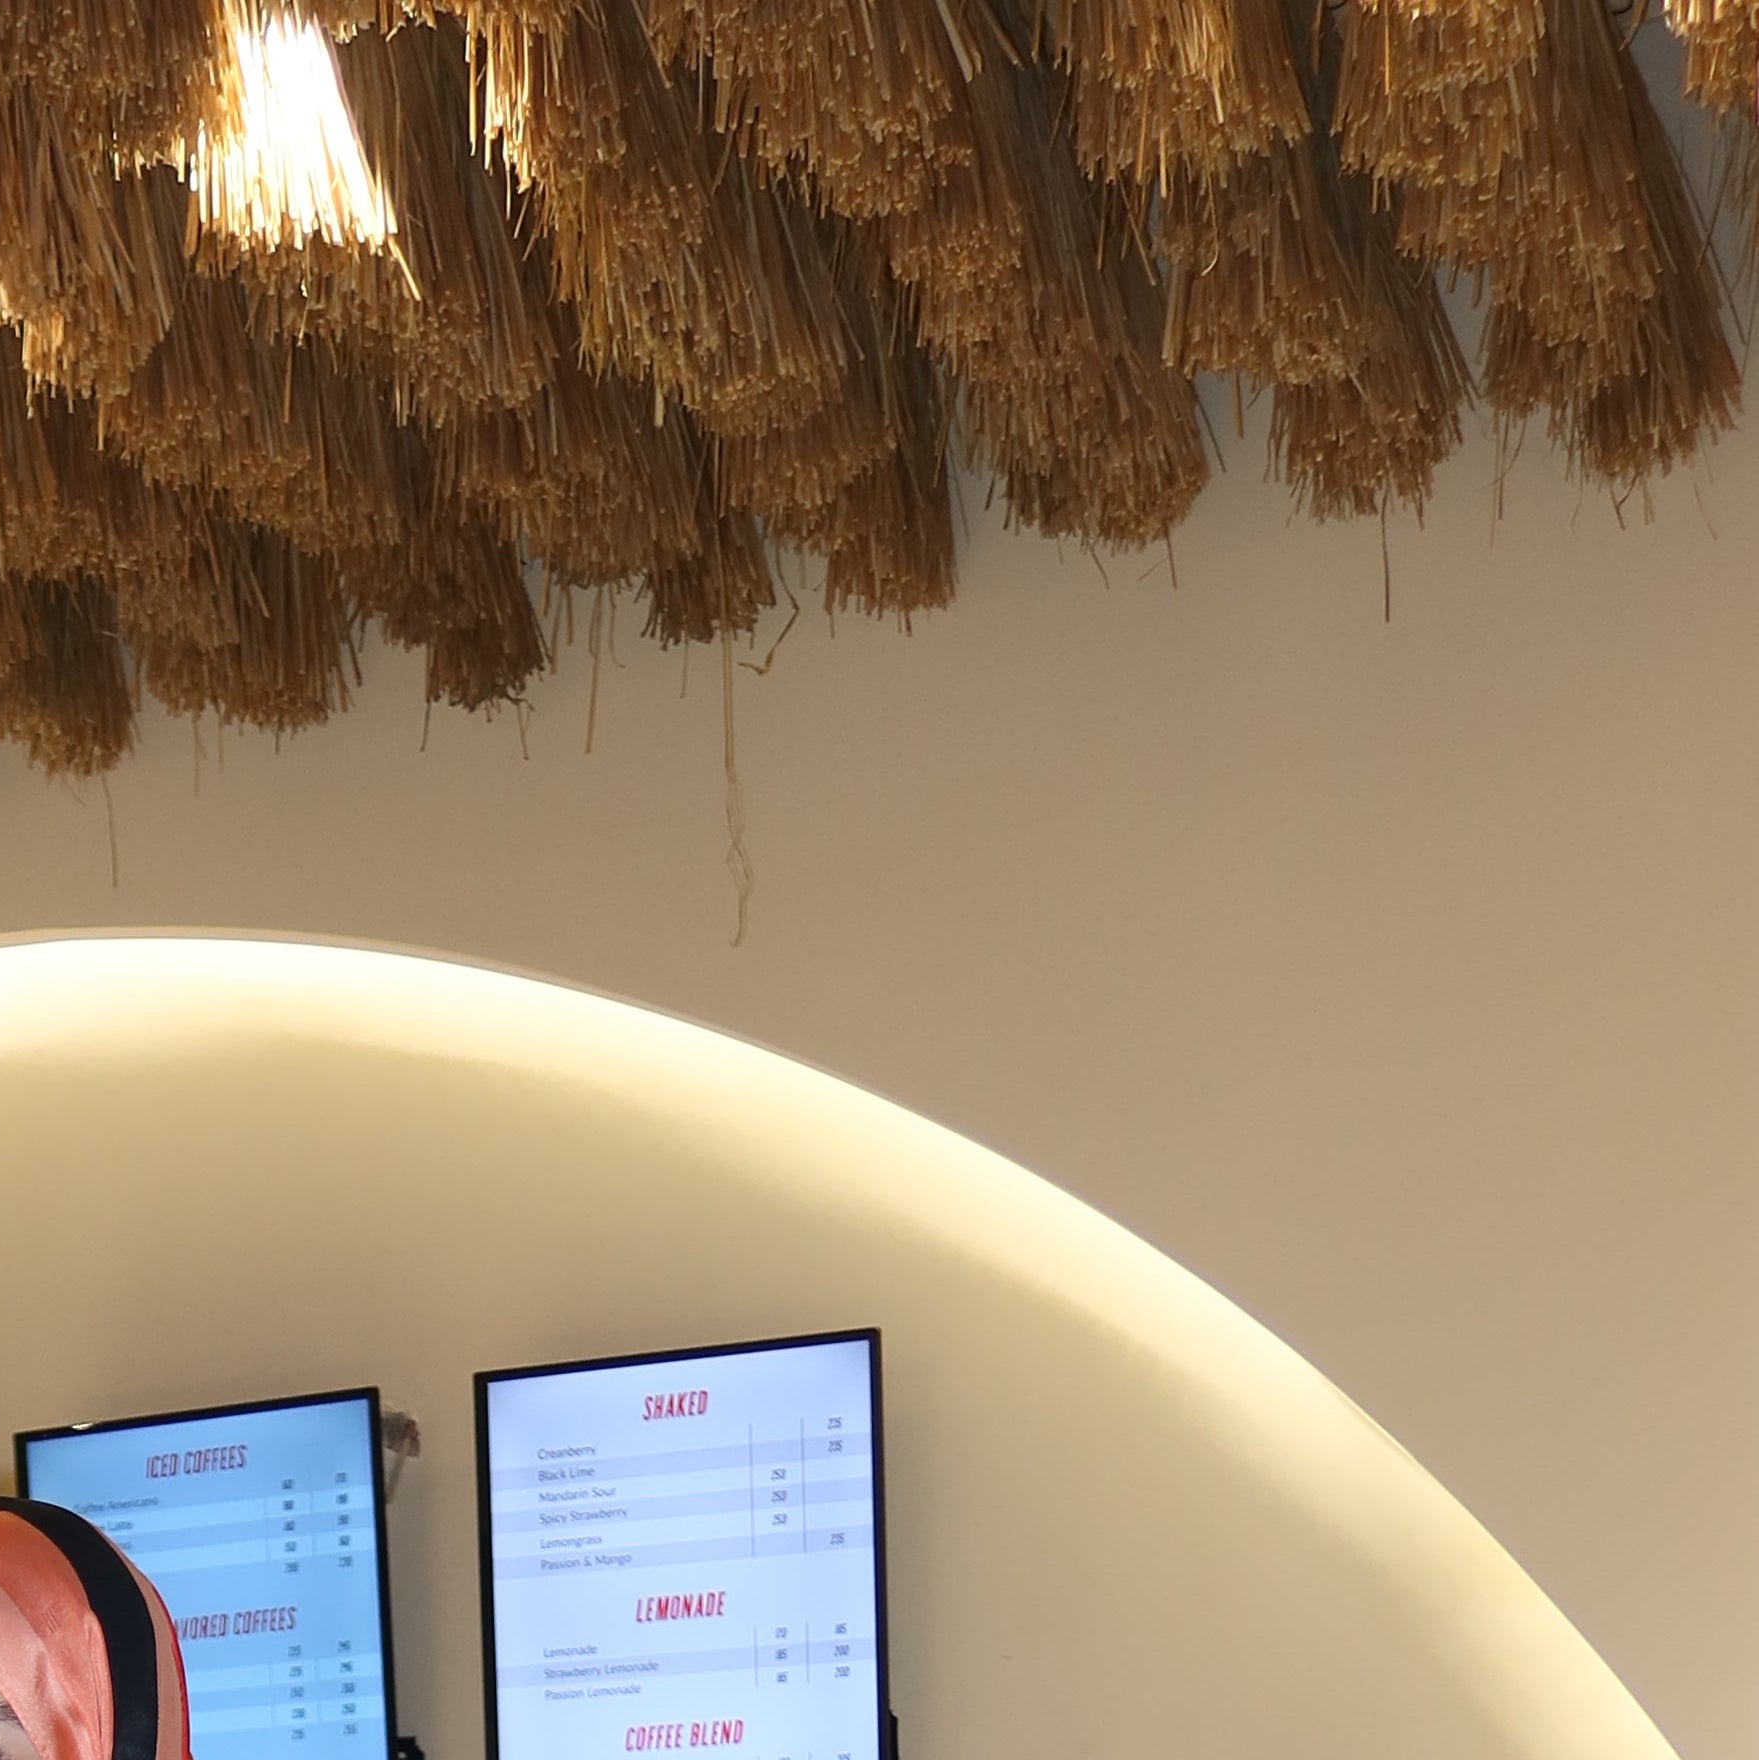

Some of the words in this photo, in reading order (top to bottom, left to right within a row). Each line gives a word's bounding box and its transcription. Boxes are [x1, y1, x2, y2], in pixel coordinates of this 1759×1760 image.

[642, 1390, 709, 1421] SHAKED
[146, 1453, 179, 1479] ICED
[183, 1444, 248, 1475] COFFEES
[174, 1612, 228, 1640] VORED
[232, 1606, 297, 1636] COFFEES
[636, 1591, 725, 1623] LEMONADE
[625, 1723, 683, 1752] COFFEE
[690, 1719, 744, 1747] BLEND
